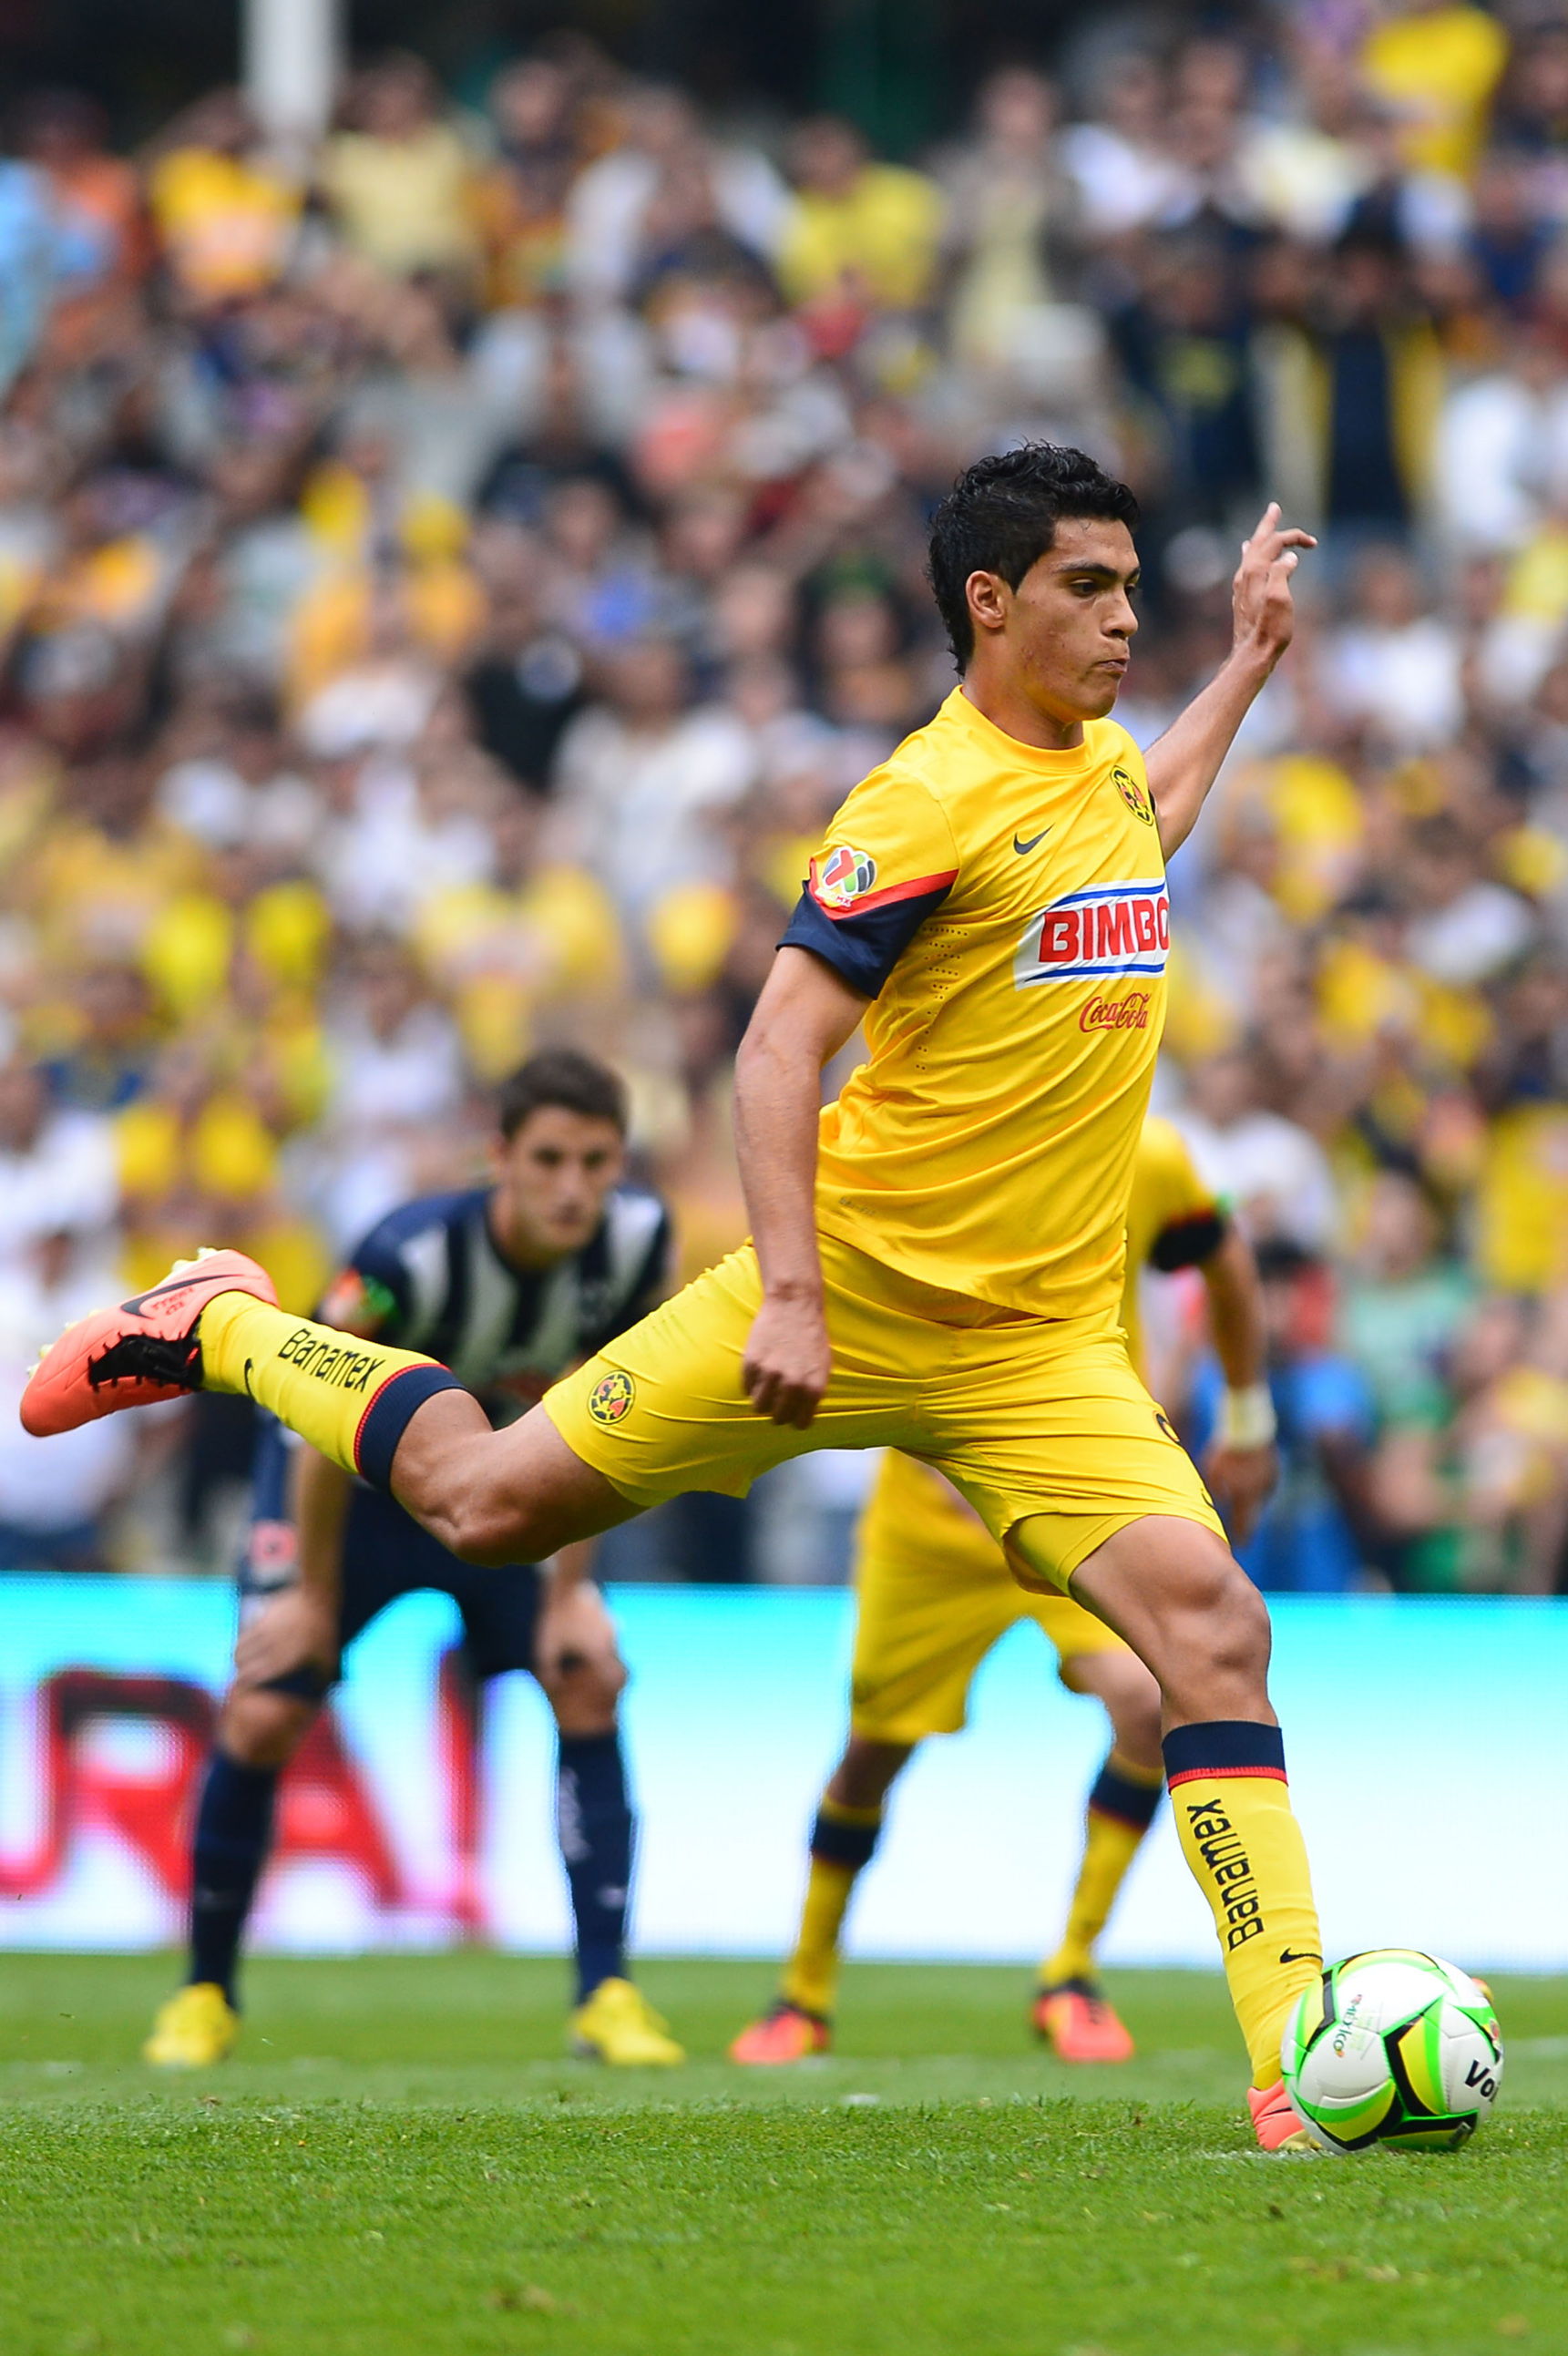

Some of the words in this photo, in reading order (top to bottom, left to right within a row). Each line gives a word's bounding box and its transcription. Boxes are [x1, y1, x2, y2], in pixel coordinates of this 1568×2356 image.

[1039, 896, 1169, 963] BIMBO
[1079, 992, 1150, 1033] Coca-Cola
[277, 1328, 385, 1392] Banamex
[1186, 1798, 1264, 1951] Banamex
